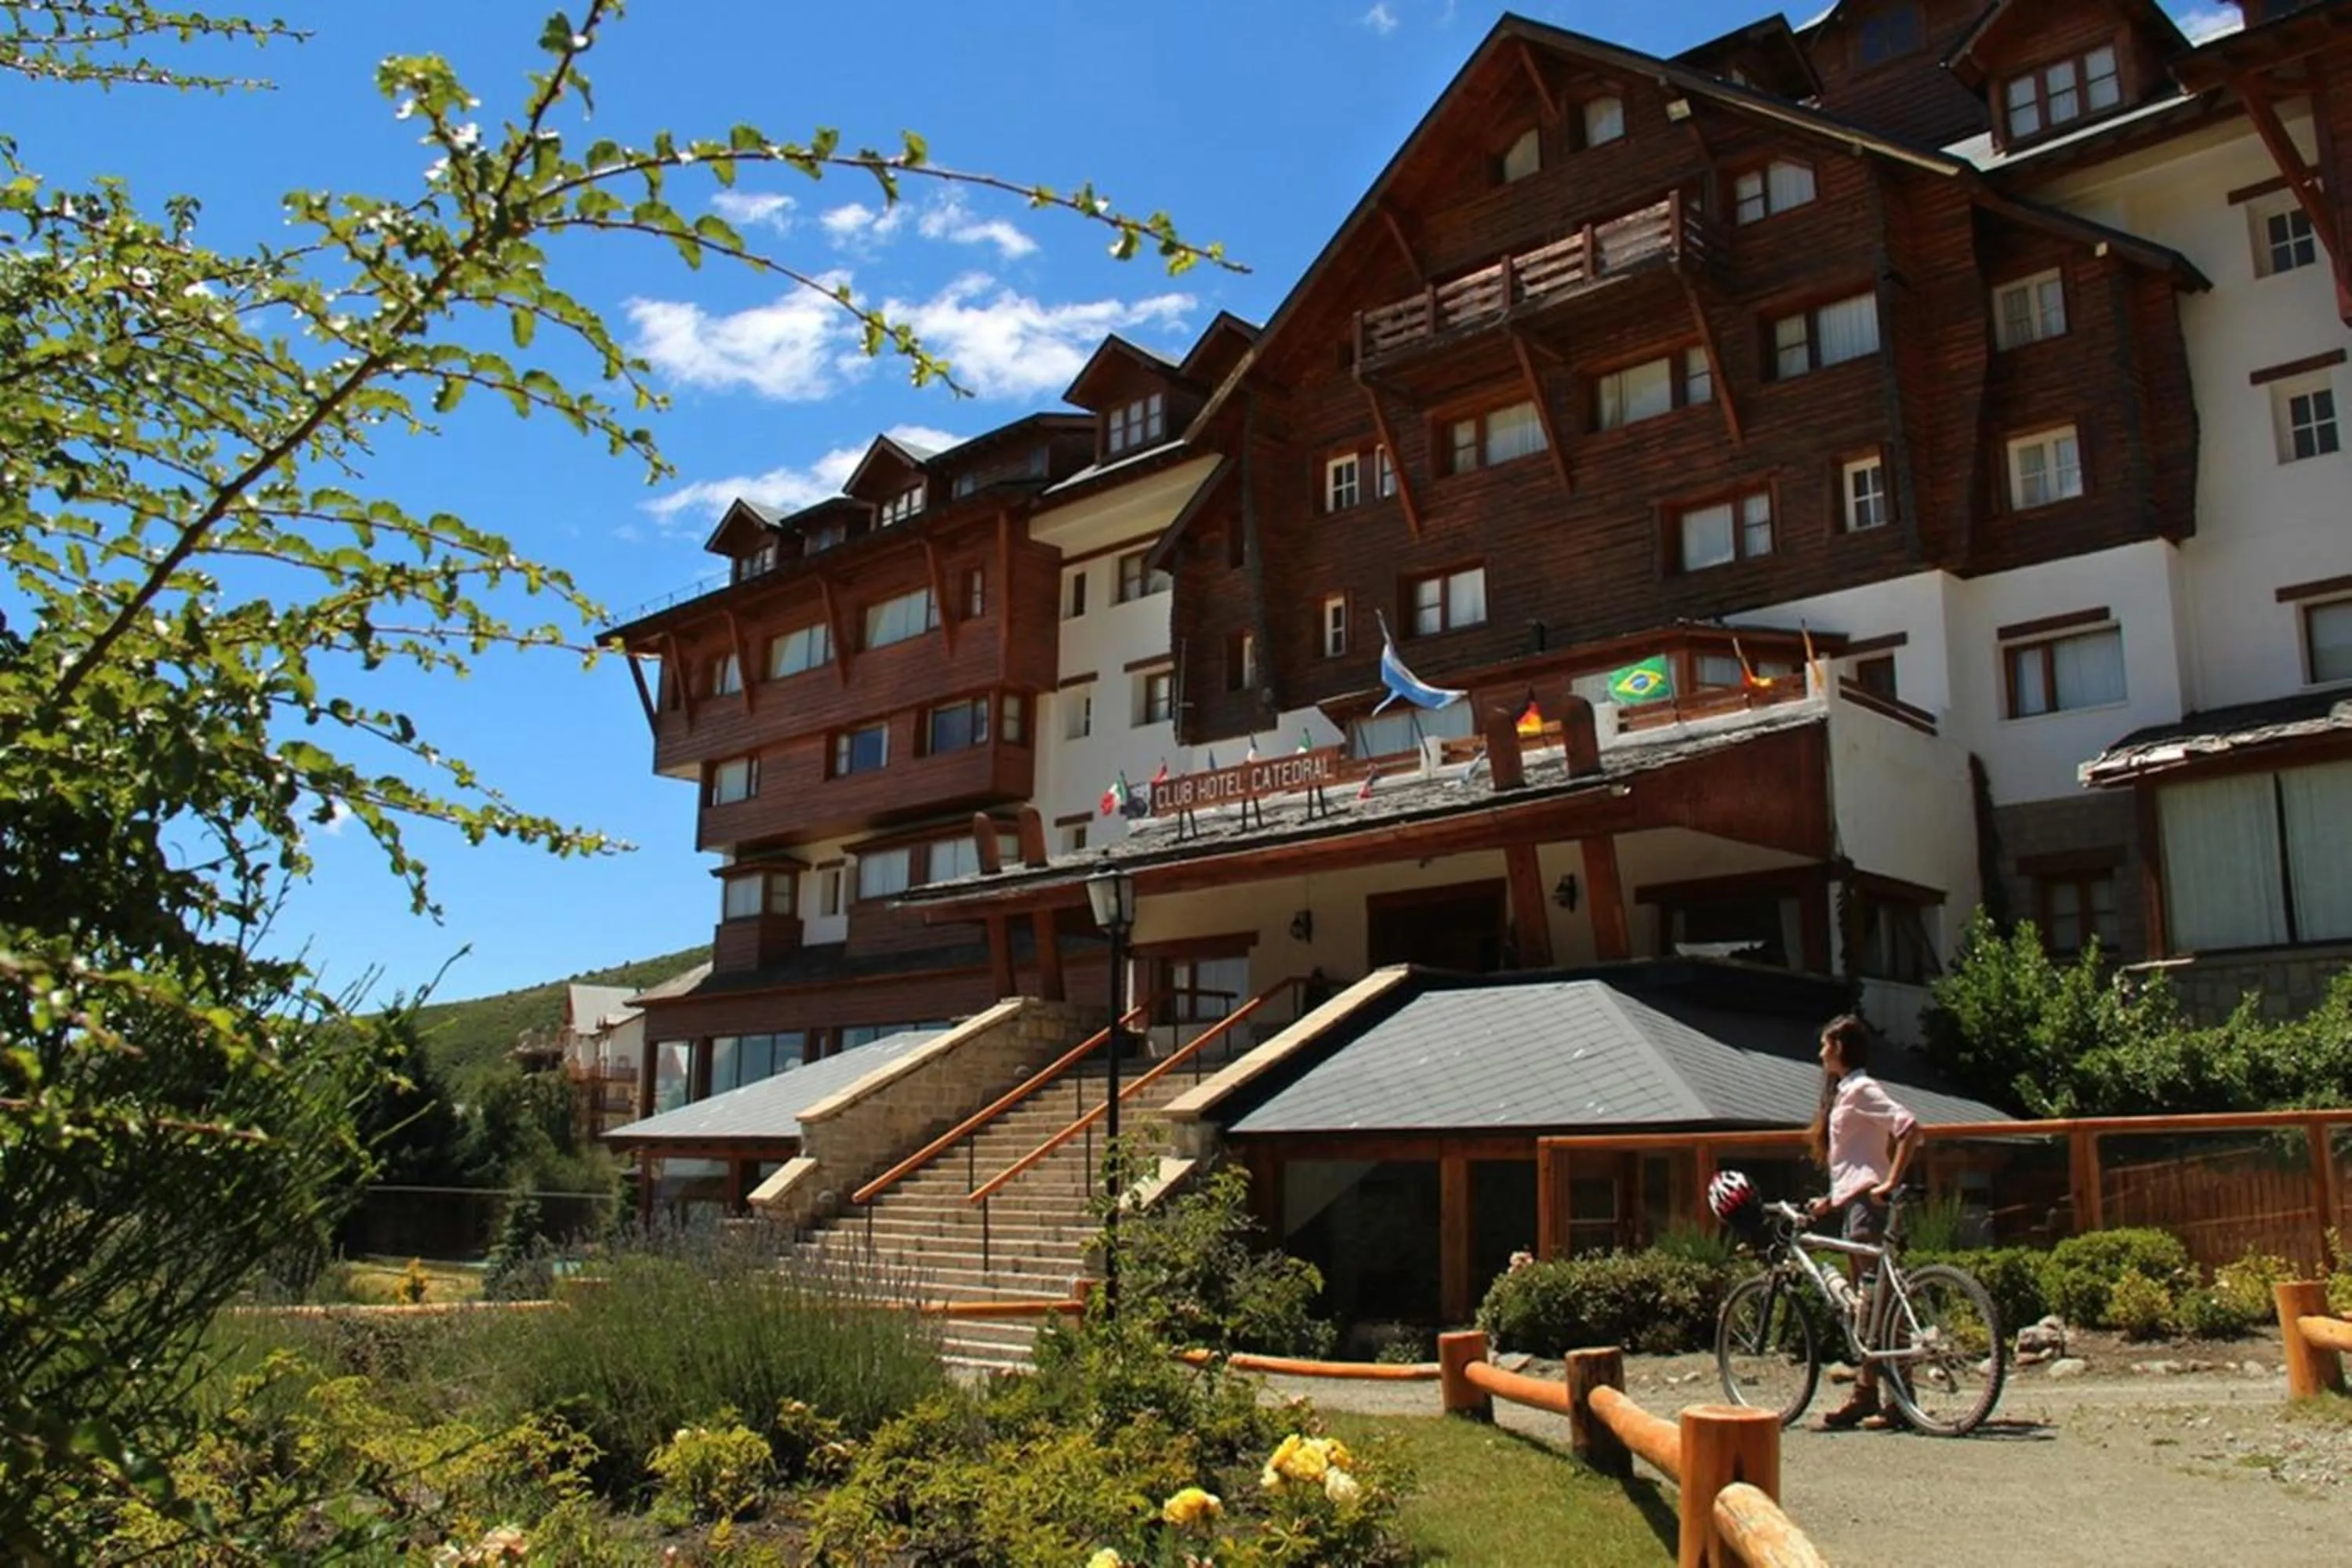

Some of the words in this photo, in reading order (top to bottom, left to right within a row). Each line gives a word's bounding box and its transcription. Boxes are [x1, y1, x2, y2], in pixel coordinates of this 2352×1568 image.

[1156, 782, 1192, 808] CLUB
[1198, 772, 1244, 800] HOTEL
[1251, 757, 1333, 790] CATEDRAL
